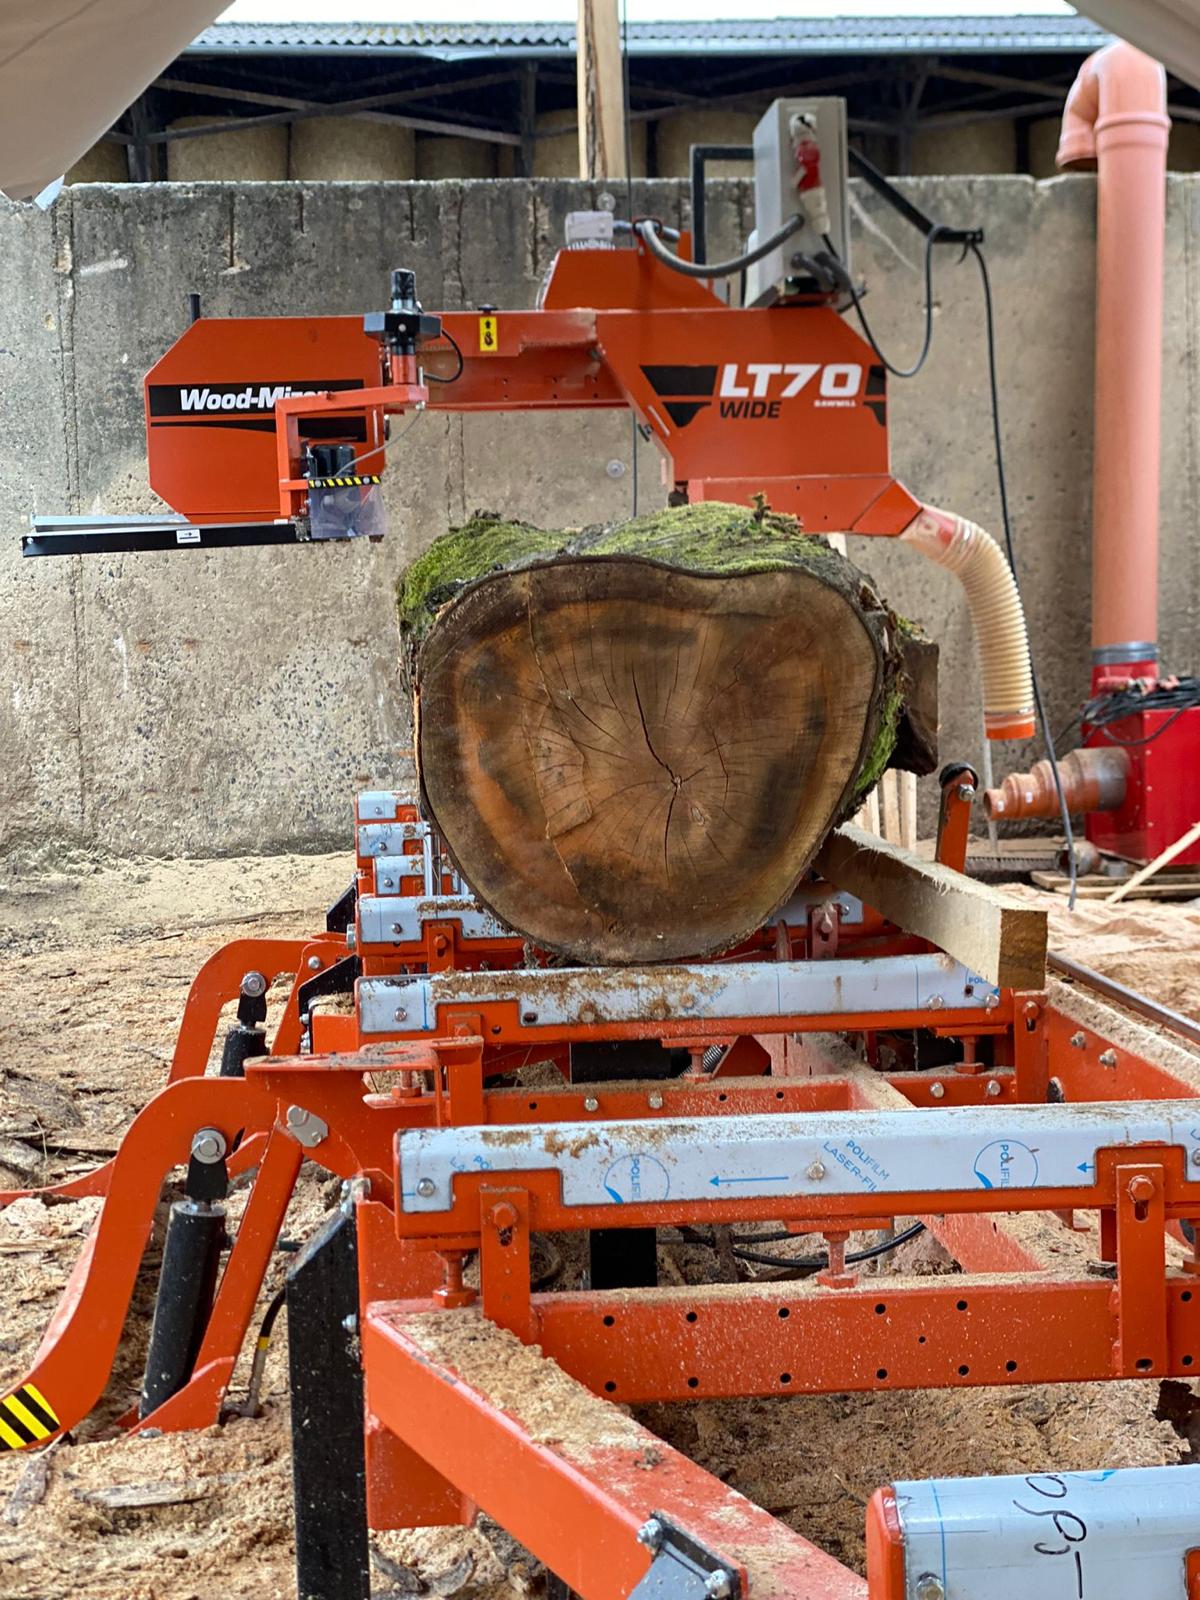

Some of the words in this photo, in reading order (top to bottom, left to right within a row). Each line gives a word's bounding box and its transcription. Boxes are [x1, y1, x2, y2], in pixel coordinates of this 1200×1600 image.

[719, 363, 862, 398] LT70
[719, 401, 782, 419] WIDE
[845, 1140, 890, 1181] POLIFILM
